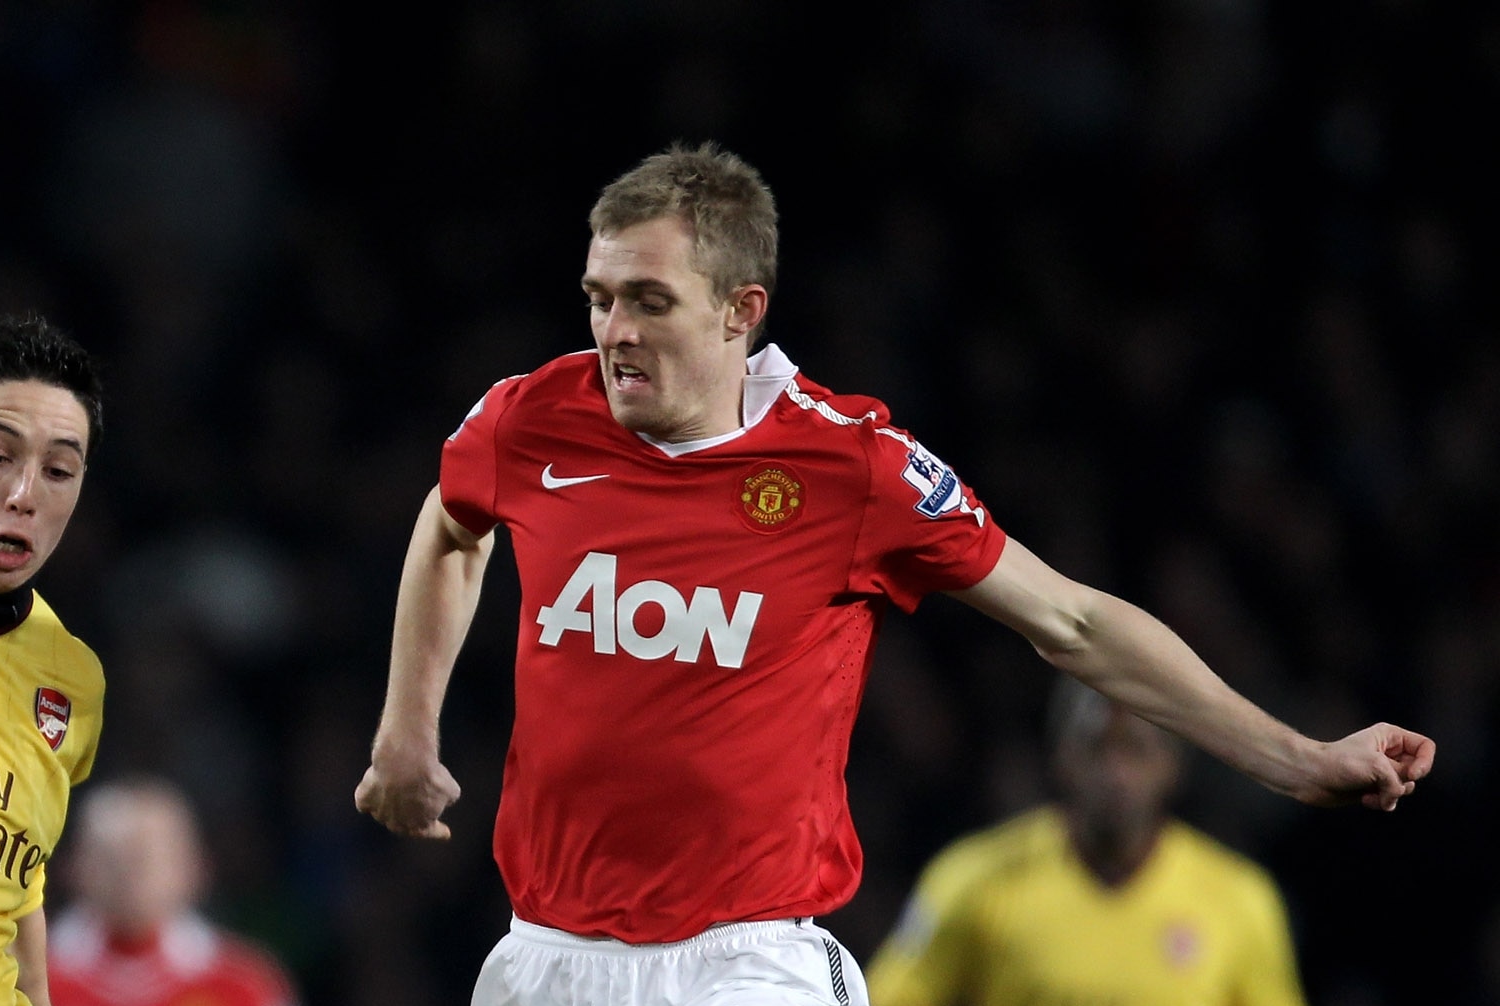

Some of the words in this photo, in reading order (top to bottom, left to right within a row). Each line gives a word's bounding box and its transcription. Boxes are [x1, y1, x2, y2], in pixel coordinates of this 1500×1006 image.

[748, 473, 796, 494] MANCHESTER
[752, 509, 785, 520] UNITED
[536, 551, 764, 669] AON
[40, 696, 67, 716] Arsenal
